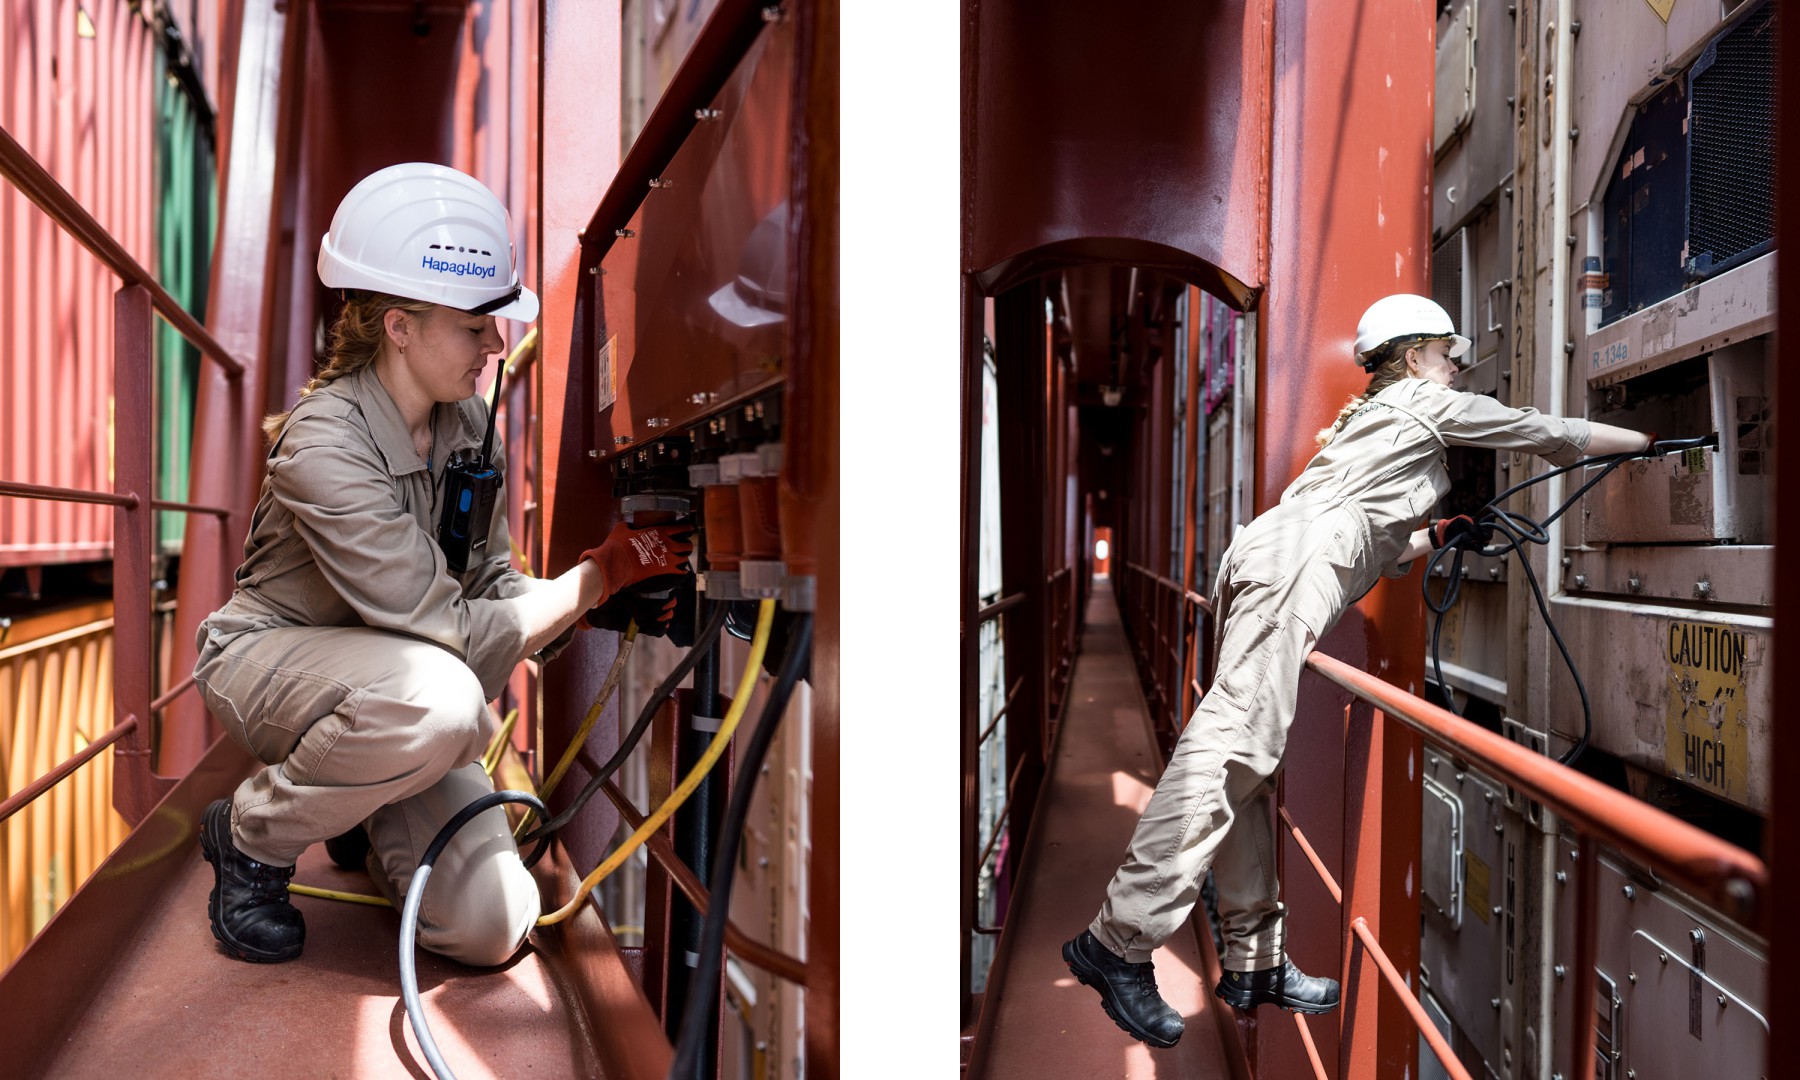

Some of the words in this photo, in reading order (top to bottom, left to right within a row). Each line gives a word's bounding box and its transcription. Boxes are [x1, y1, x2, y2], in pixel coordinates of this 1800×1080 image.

[422, 255, 496, 279] Hapag-Lloyd
[1669, 622, 1745, 676] CAUTION
[1684, 732, 1725, 790] HIGH
